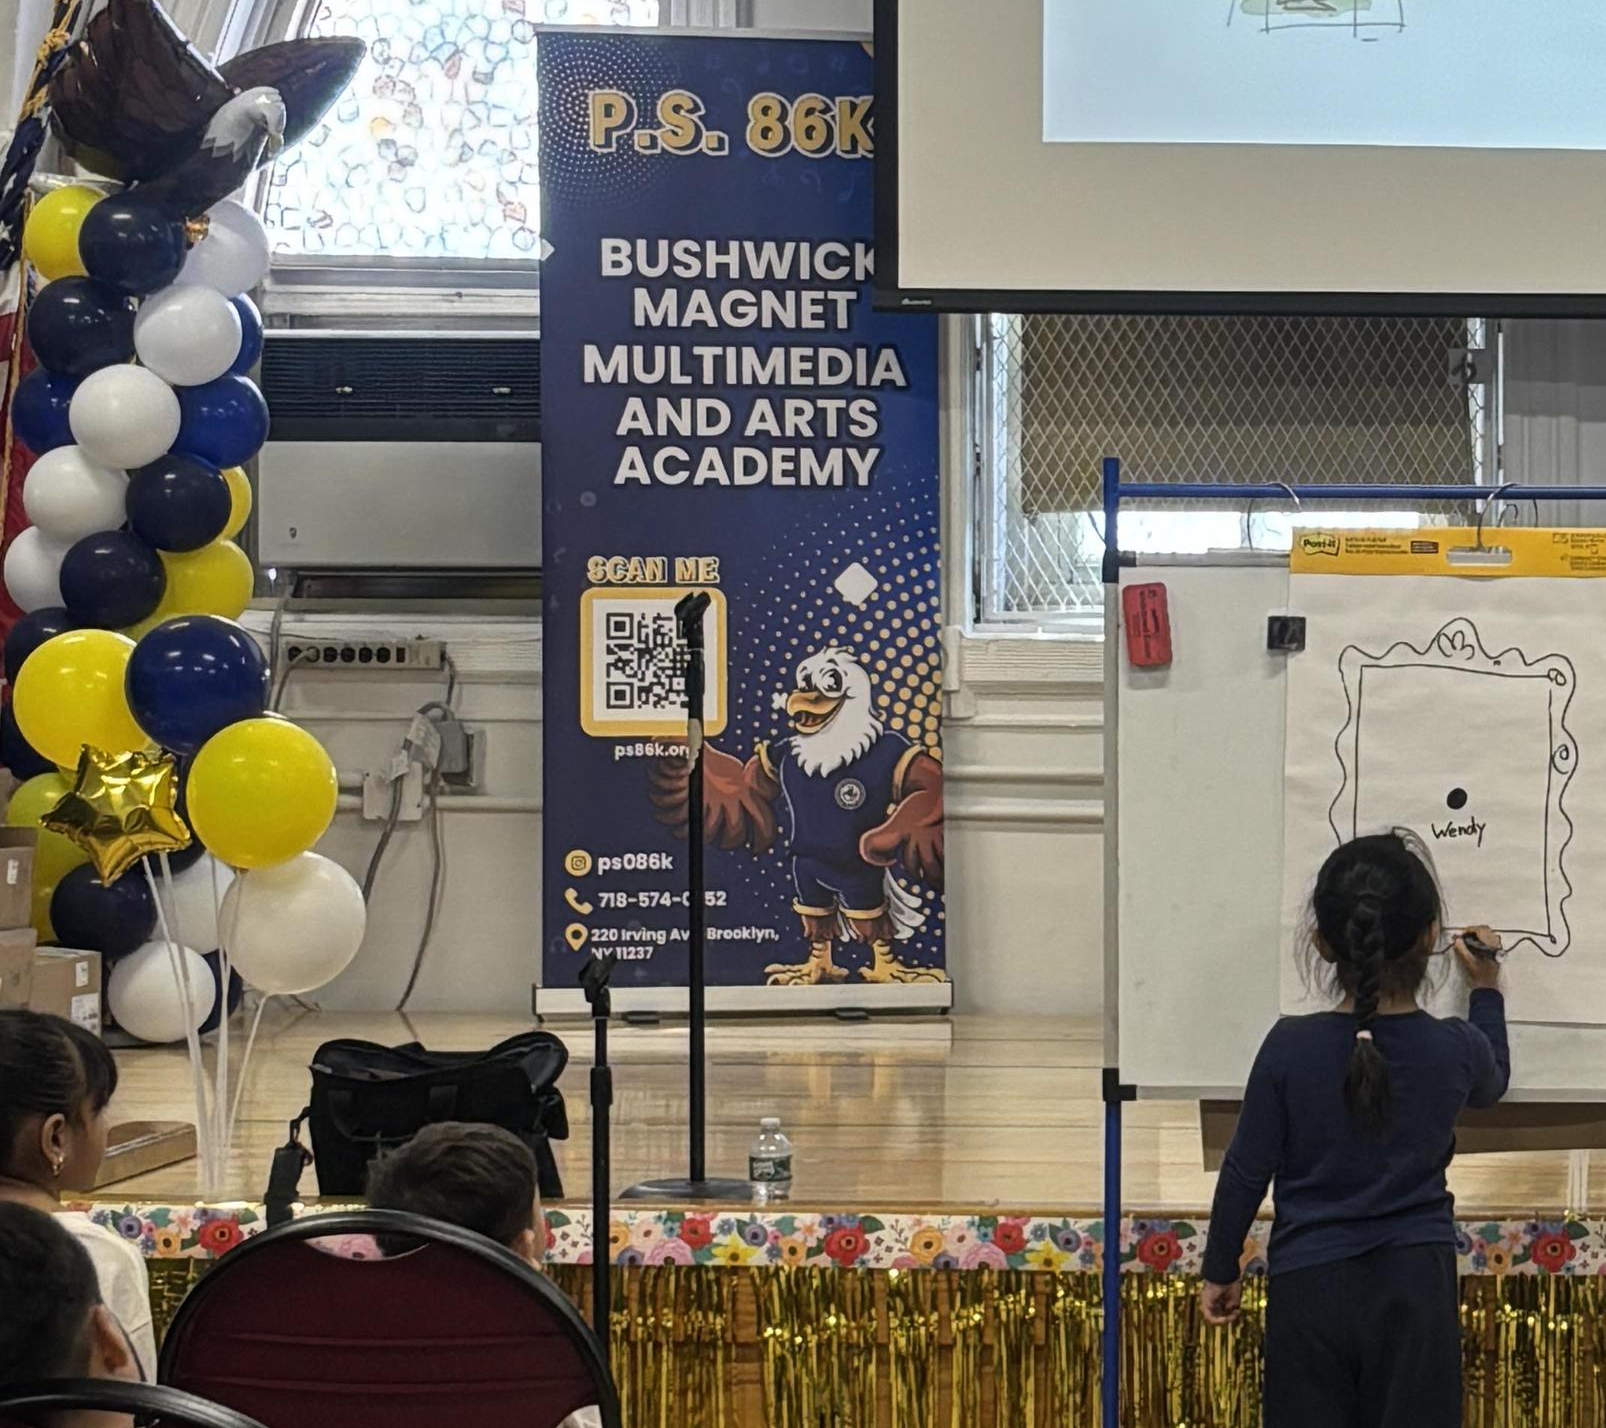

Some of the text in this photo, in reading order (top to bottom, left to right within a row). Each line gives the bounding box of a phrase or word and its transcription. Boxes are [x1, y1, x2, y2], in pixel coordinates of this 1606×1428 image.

[589, 88, 875, 159] P.S. 86K
[634, 287, 858, 330] MAGNET
[583, 344, 908, 388] MULTIMEDIA
[615, 397, 879, 439] AND ARTS
[613, 446, 880, 486] ACADEMY
[587, 555, 720, 584] SCAN ME
[1431, 815, 1487, 848] Wendy
[597, 852, 674, 875] ps086k
[598, 890, 728, 909] 718-574-052
[591, 926, 780, 945] 220 Irving Av Brooklyn,
[616, 946, 654, 960] 11237
